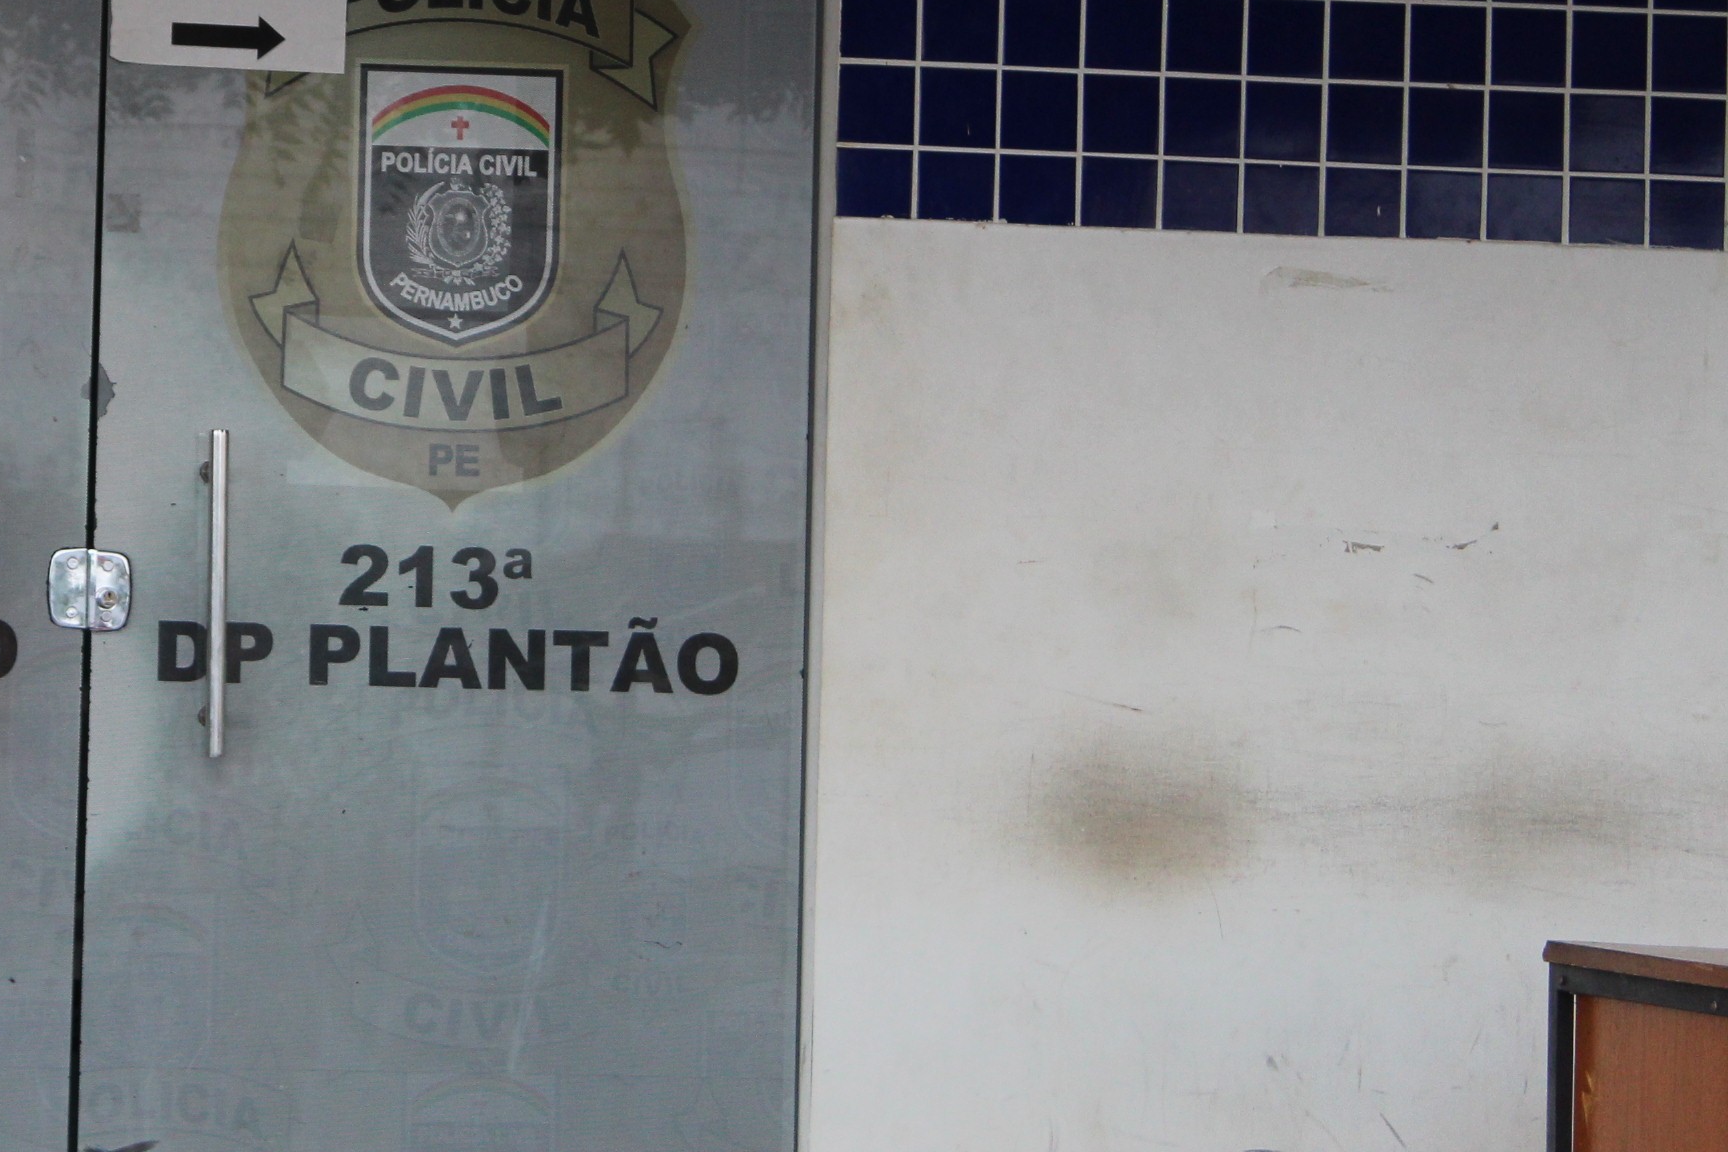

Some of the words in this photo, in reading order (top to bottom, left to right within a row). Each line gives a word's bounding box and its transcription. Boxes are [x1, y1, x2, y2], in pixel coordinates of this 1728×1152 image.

[381, 148, 473, 175] POLÍCIA
[479, 154, 537, 177] CIVIL
[389, 270, 522, 311] PERNAMBUCO
[349, 357, 563, 421] CIVIL
[427, 444, 480, 476] PE
[339, 545, 532, 611] 213ª
[157, 620, 274, 684] DP
[308, 617, 739, 696] PLANTÃO
